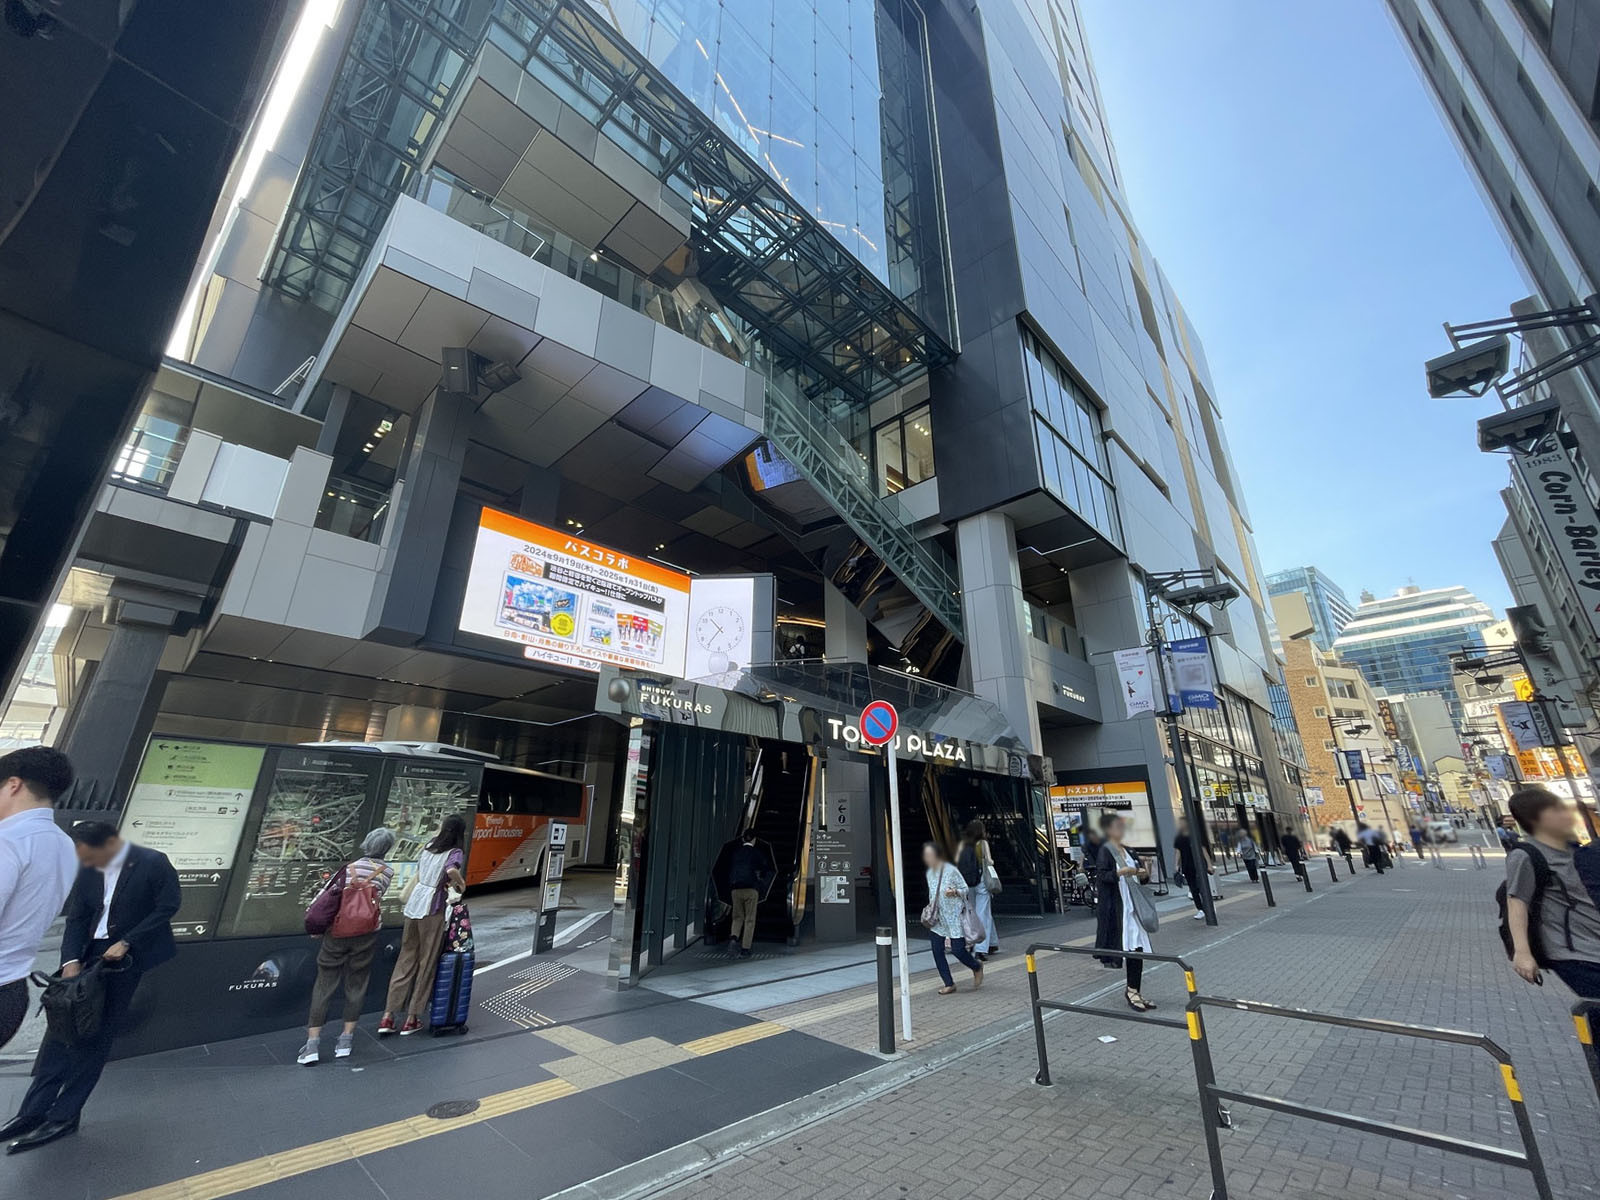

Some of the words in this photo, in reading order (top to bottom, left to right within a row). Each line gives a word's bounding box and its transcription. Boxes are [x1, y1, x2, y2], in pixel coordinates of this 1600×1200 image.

[1524, 454, 1562, 469] 1983
[1538, 470, 1600, 591] Corn-Barley
[564, 540, 629, 570] バスコラボ
[641, 685, 675, 696] SHIBUYA
[640, 692, 712, 714] FUKURAS
[907, 734, 967, 762] PLAZA
[493, 826, 523, 839] Limousine
[228, 981, 278, 991] FUKURAS
